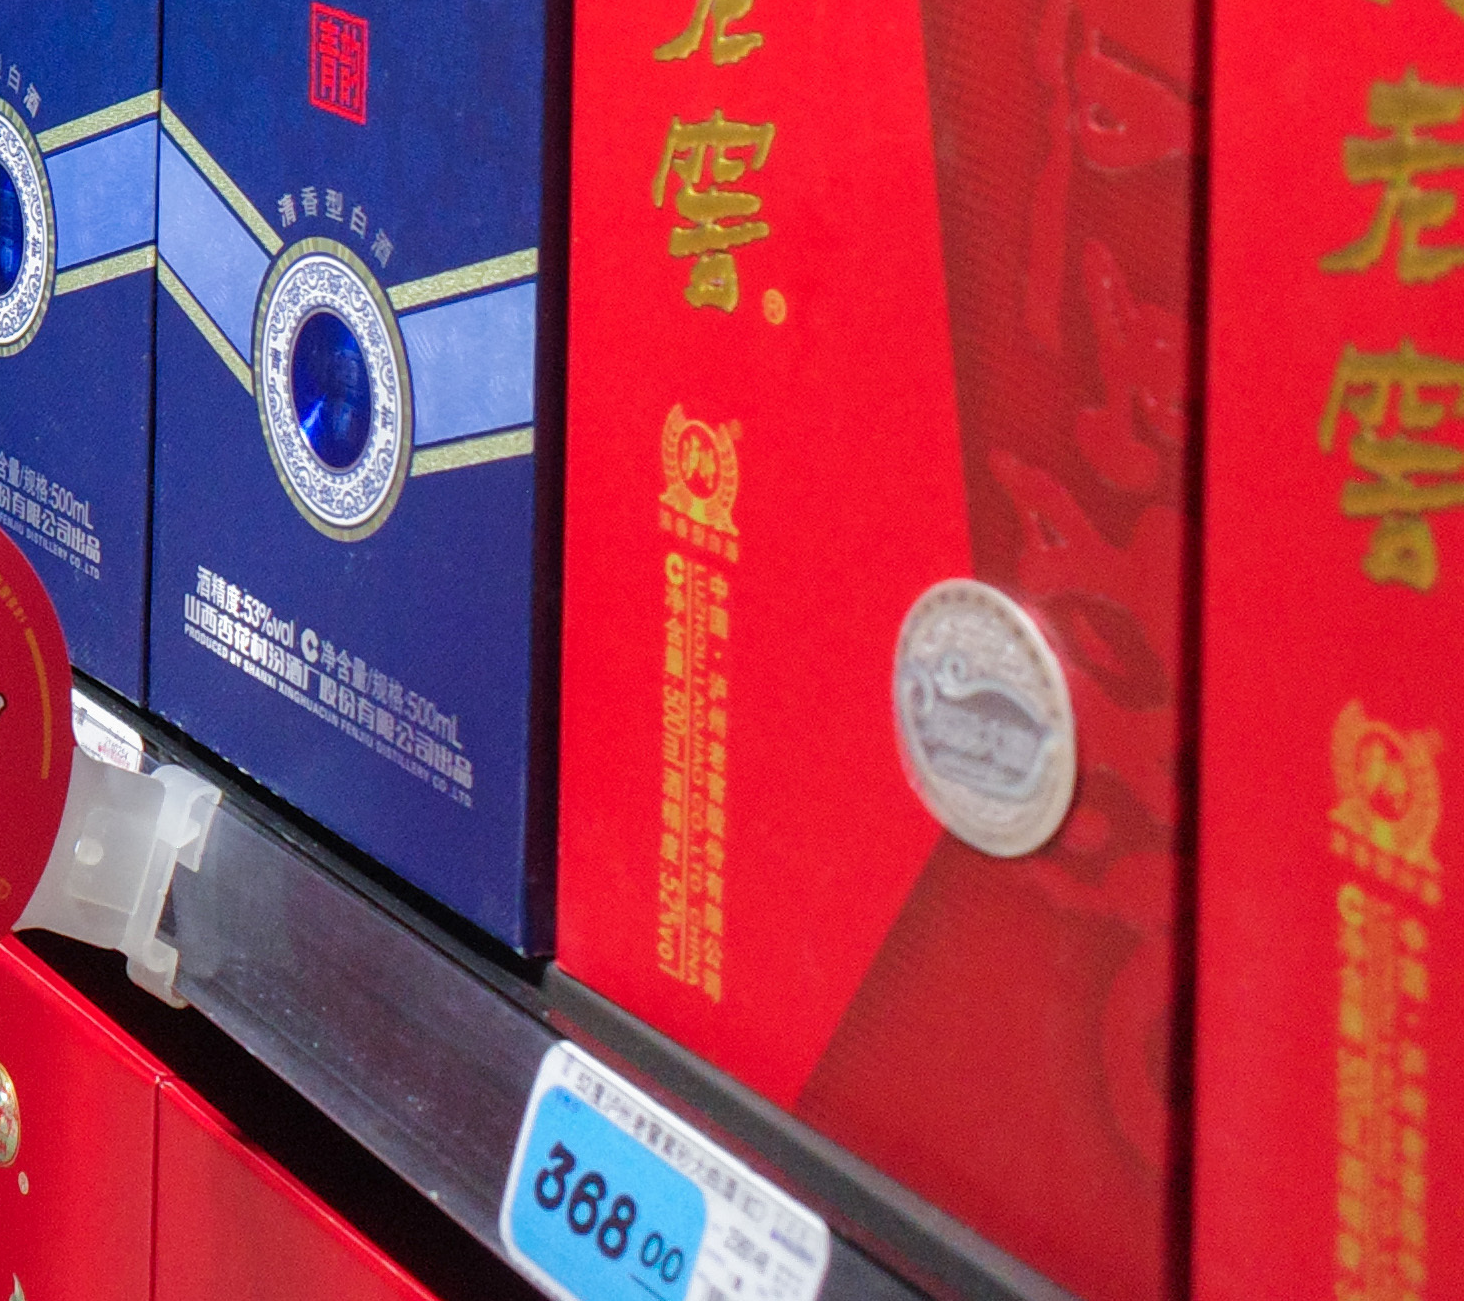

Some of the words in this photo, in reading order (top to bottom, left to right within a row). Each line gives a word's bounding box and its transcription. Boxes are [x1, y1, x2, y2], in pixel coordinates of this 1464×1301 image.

[277, 185, 395, 270] 清香型白酒
[184, 623, 228, 660] PRODUCED
[229, 650, 242, 669] BY
[243, 658, 277, 690] SHANXI
[534, 1140, 638, 1260] 368
